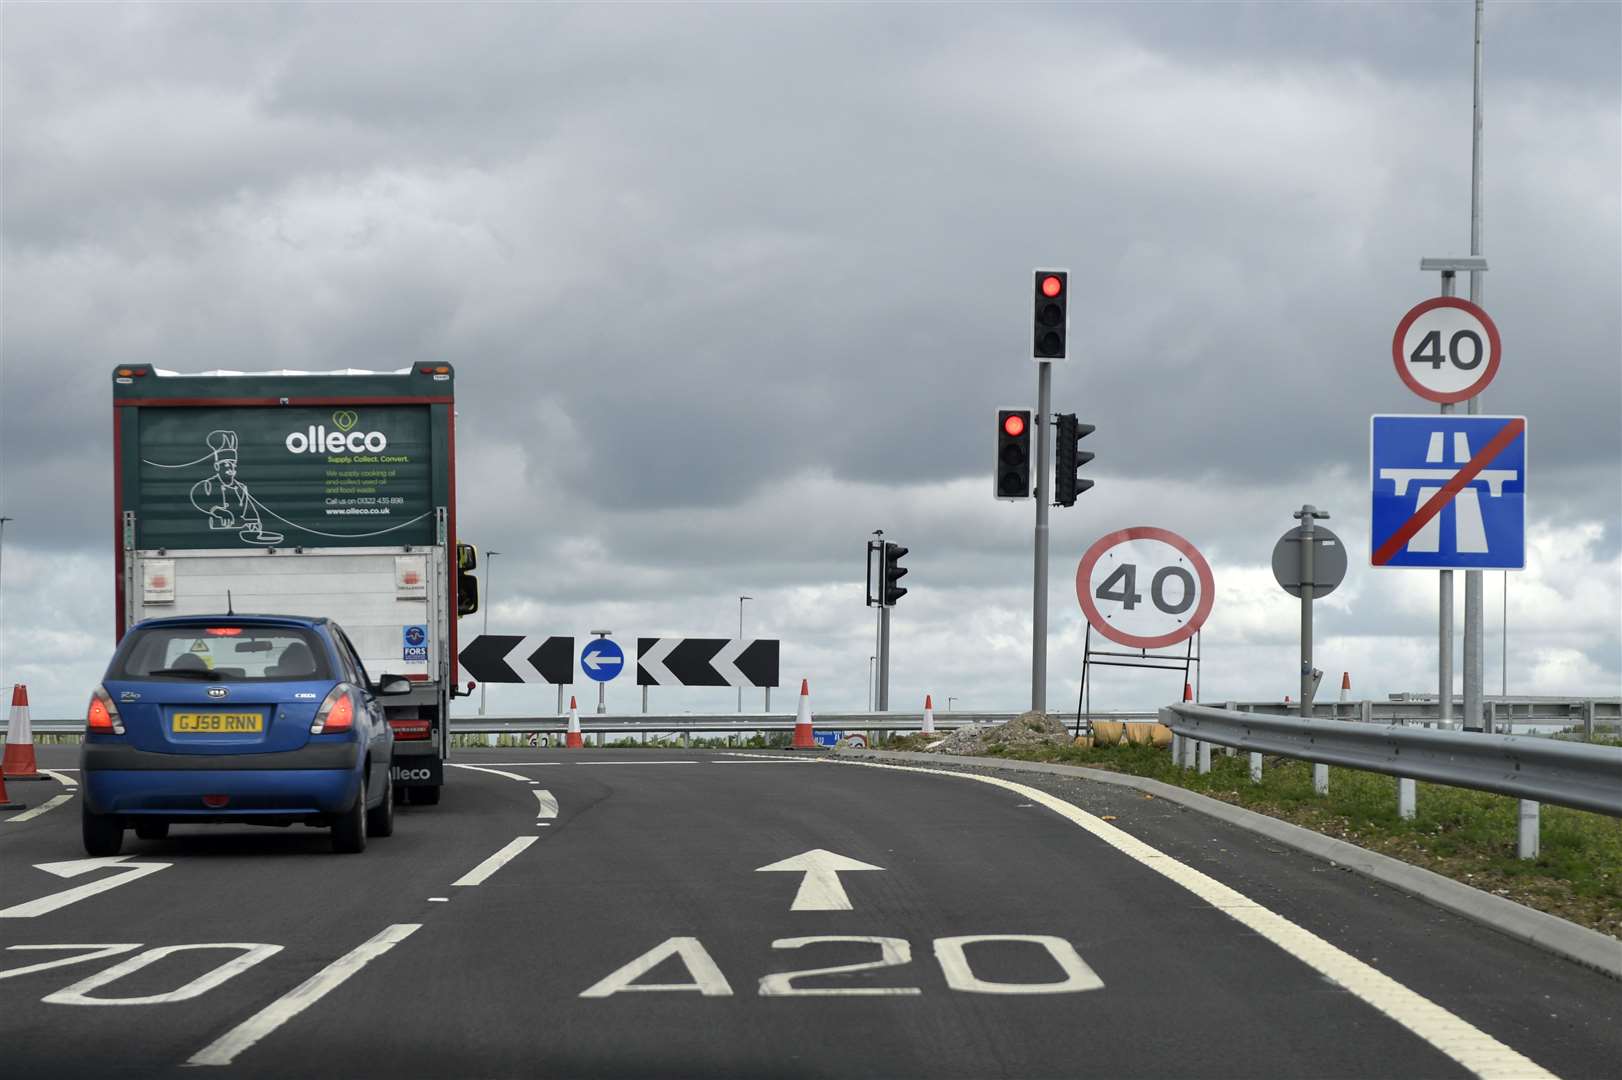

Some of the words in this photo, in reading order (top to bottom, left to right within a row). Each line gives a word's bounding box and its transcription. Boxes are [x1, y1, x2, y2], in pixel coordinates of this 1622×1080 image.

[1410, 329, 1484, 370] 40
[286, 425, 387, 454] olleco
[380, 455, 409, 463] Convert.
[325, 507, 391, 515] www.olleco.co.uk
[1095, 562, 1196, 615] 40
[179, 715, 220, 730] GJ58
[225, 715, 257, 730] RNN
[391, 766, 431, 780] lleco
[577, 934, 1105, 998] A20
